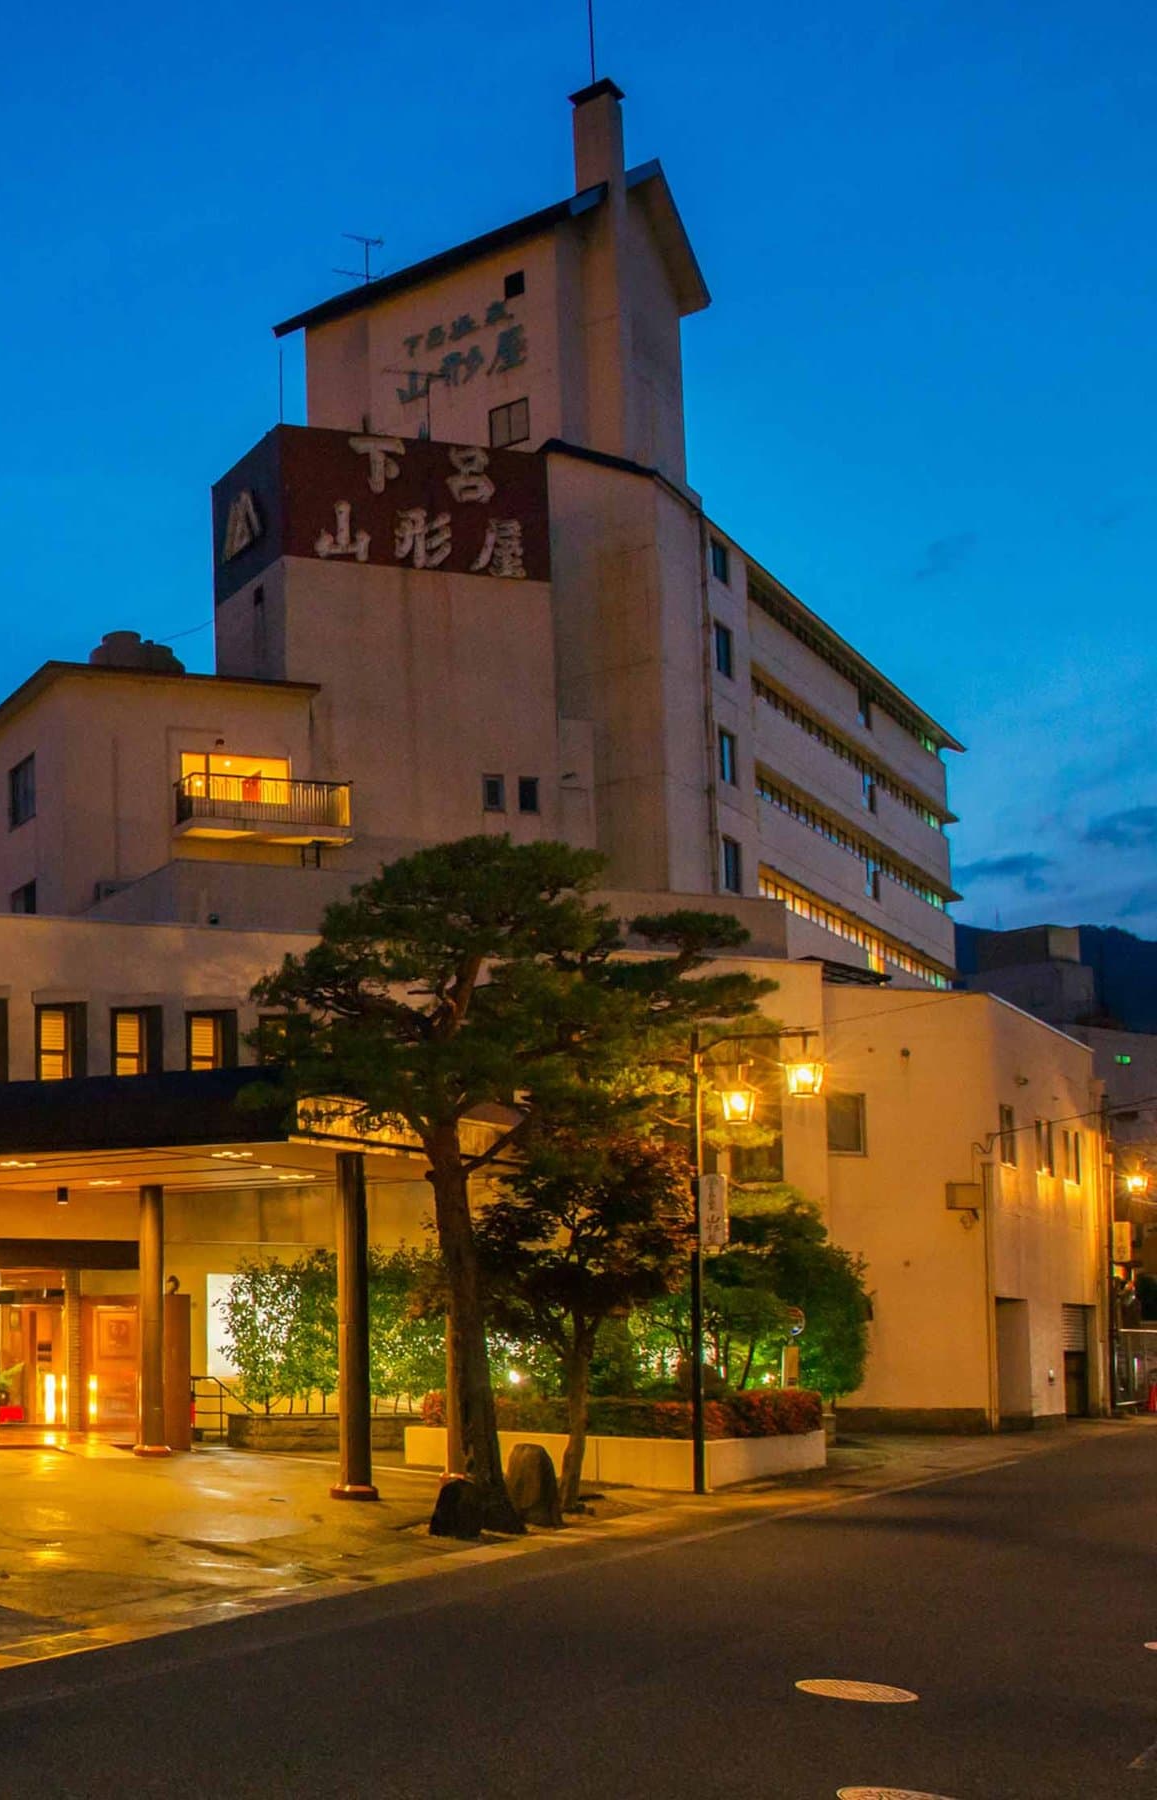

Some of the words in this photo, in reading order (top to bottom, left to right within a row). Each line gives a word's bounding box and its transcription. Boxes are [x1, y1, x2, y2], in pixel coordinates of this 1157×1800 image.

[348, 436, 495, 503] 下呂
[314, 502, 526, 578] 山形屋
